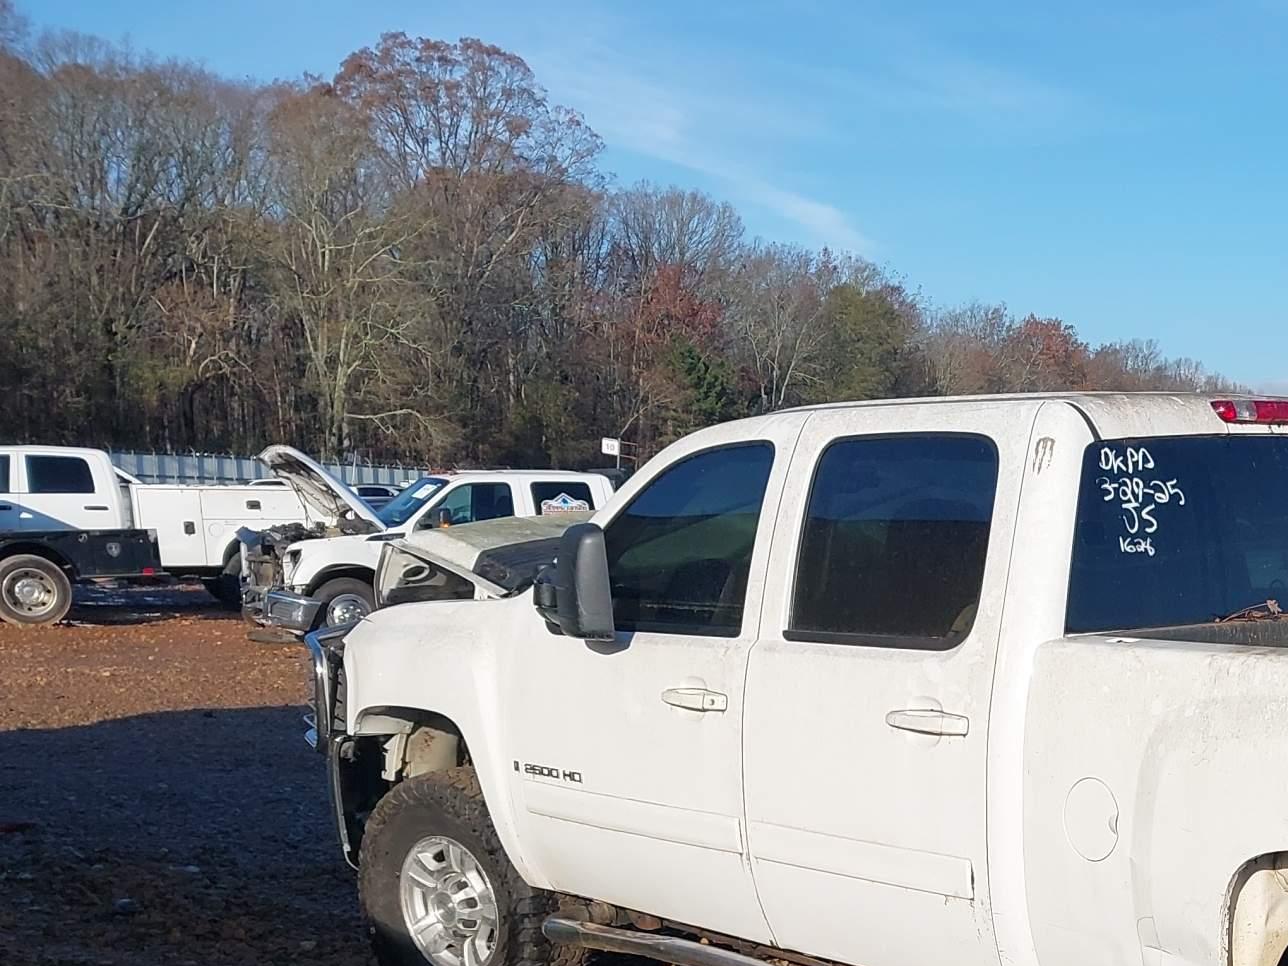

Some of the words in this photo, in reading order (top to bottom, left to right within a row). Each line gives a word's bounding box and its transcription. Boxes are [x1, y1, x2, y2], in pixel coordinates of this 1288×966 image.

[1095, 476, 1186, 506] 3-29-25
[1121, 502, 1158, 534] JS
[524, 763, 560, 779] 2500
[562, 770, 584, 784] HD
